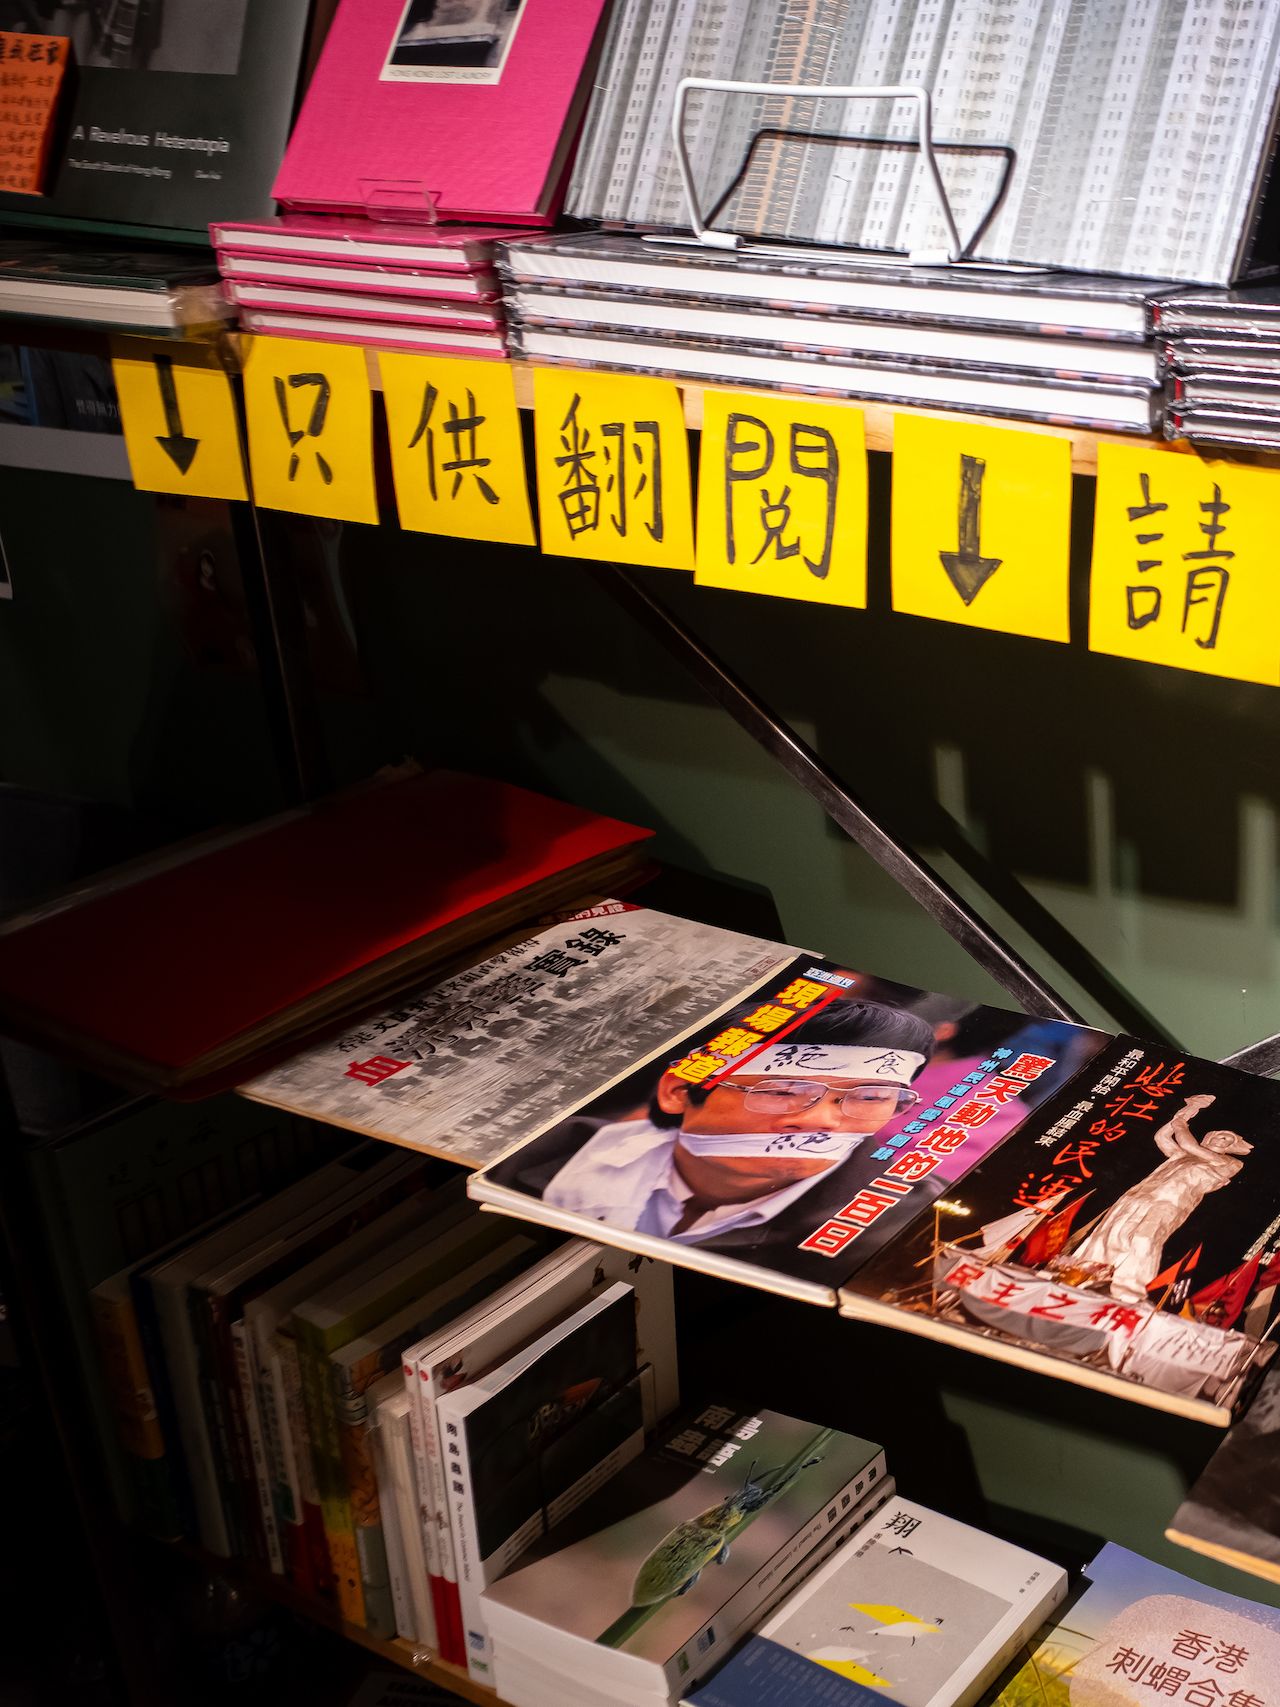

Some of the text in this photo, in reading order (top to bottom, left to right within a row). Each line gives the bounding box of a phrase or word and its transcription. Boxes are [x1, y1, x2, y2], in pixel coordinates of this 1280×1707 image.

[72, 125, 85, 140] A
[154, 131, 230, 156] Heterotopia
[344, 928, 626, 1086] 血洗京華實錄
[669, 978, 829, 1085] 現場報道
[798, 1052, 1057, 1258] 驚天動地的一百日
[1012, 1062, 1185, 1216] 悲壯的民運
[944, 1263, 1144, 1340] 民主之神
[881, 1511, 922, 1539] 翔
[1106, 1646, 1266, 1707] 刺蝟合集
[1171, 1629, 1251, 1674] 香港
